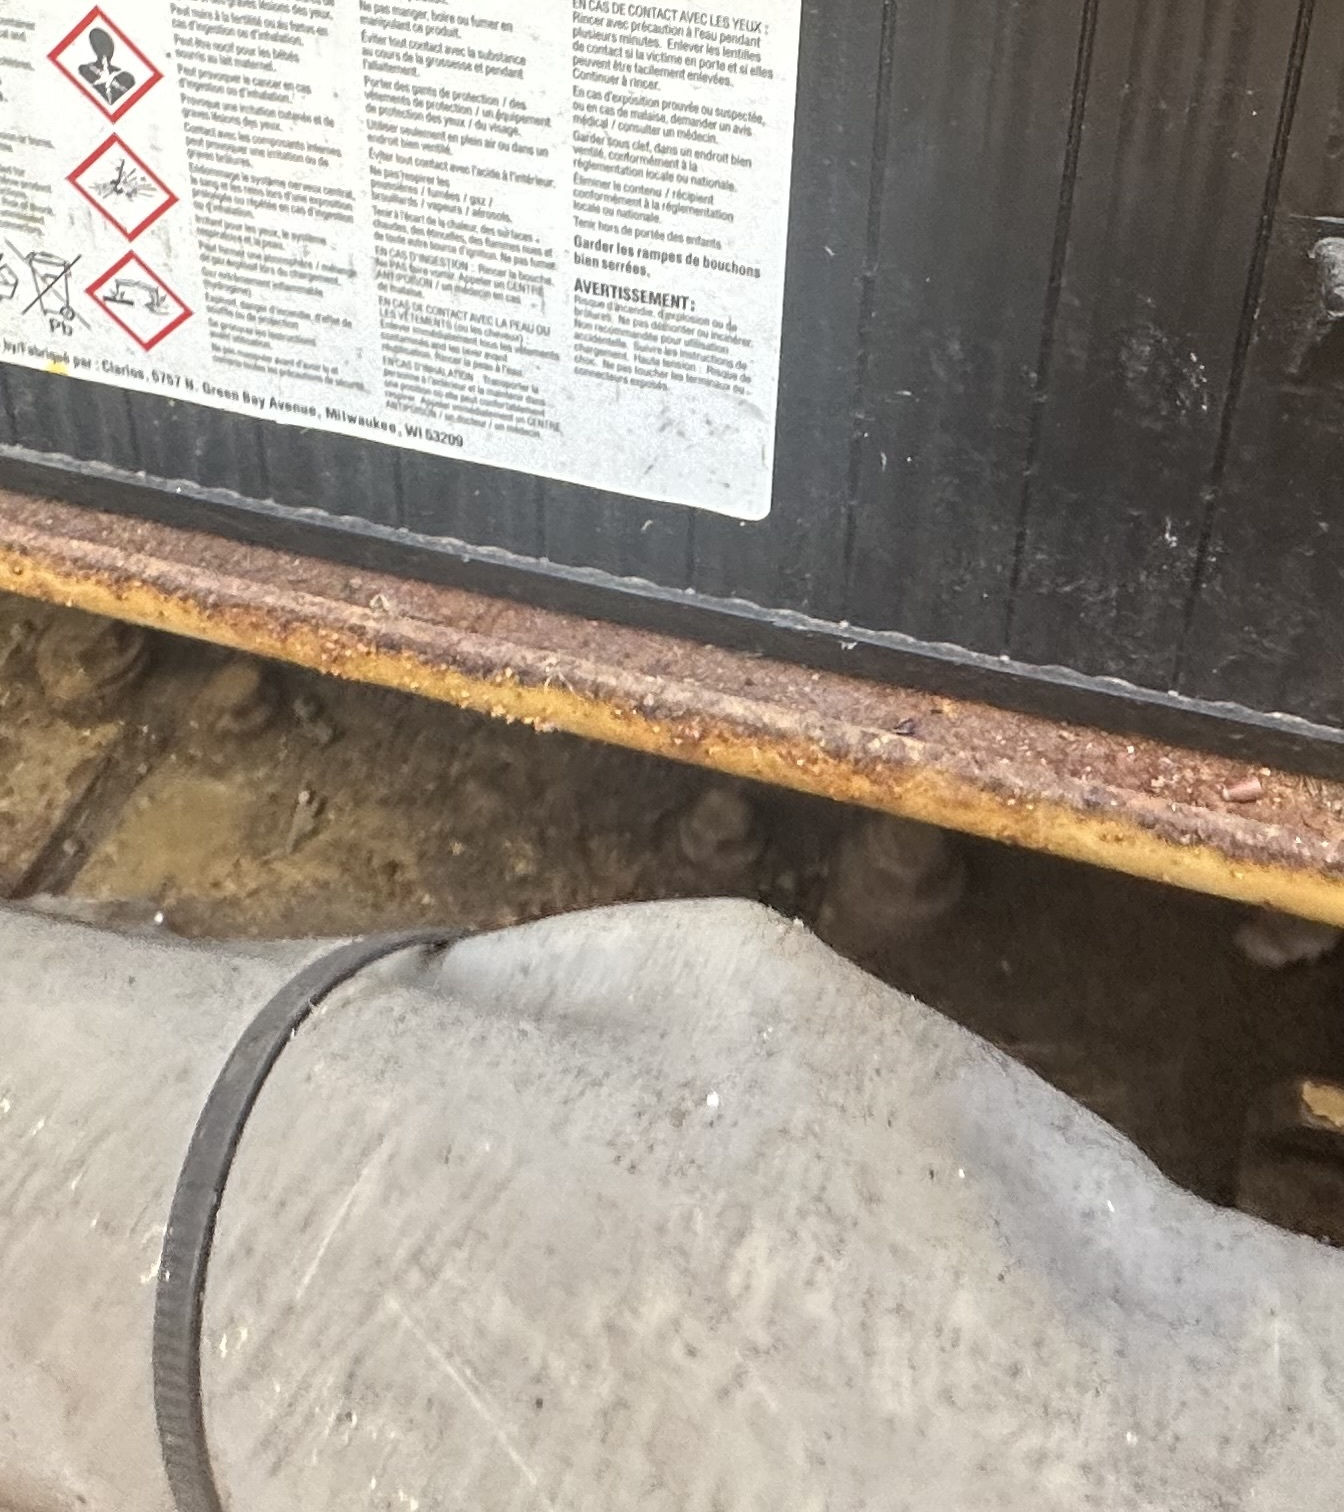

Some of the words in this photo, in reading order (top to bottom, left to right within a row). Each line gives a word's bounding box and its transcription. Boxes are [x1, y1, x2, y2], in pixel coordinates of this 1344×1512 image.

[572, 10, 605, 26] Rincer
[606, 18, 629, 30] avec
[630, 20, 684, 37] précaution
[686, 26, 692, 38] à
[694, 27, 718, 42] l'eau
[719, 32, 761, 48] pendant
[612, 1, 626, 16] DE
[628, 4, 679, 21] CONTACT
[679, 10, 708, 26] AVEC
[709, 14, 730, 29] LES
[732, 17, 762, 34] YEUX
[574, 234, 614, 254] Garder
[617, 242, 634, 258] les
[637, 248, 682, 265] rampes
[685, 253, 699, 267] de
[703, 255, 761, 279] bouchons
[574, 251, 599, 268] bien
[48, 317, 74, 337] Pb
[73, 355, 92, 369] par
[202, 381, 239, 401] Green
[242, 390, 265, 410] Bay
[269, 396, 321, 420] Avenue,
[325, 406, 402, 437] Milwaukee,
[404, 423, 423, 439] WI
[425, 428, 464, 448] 53209
